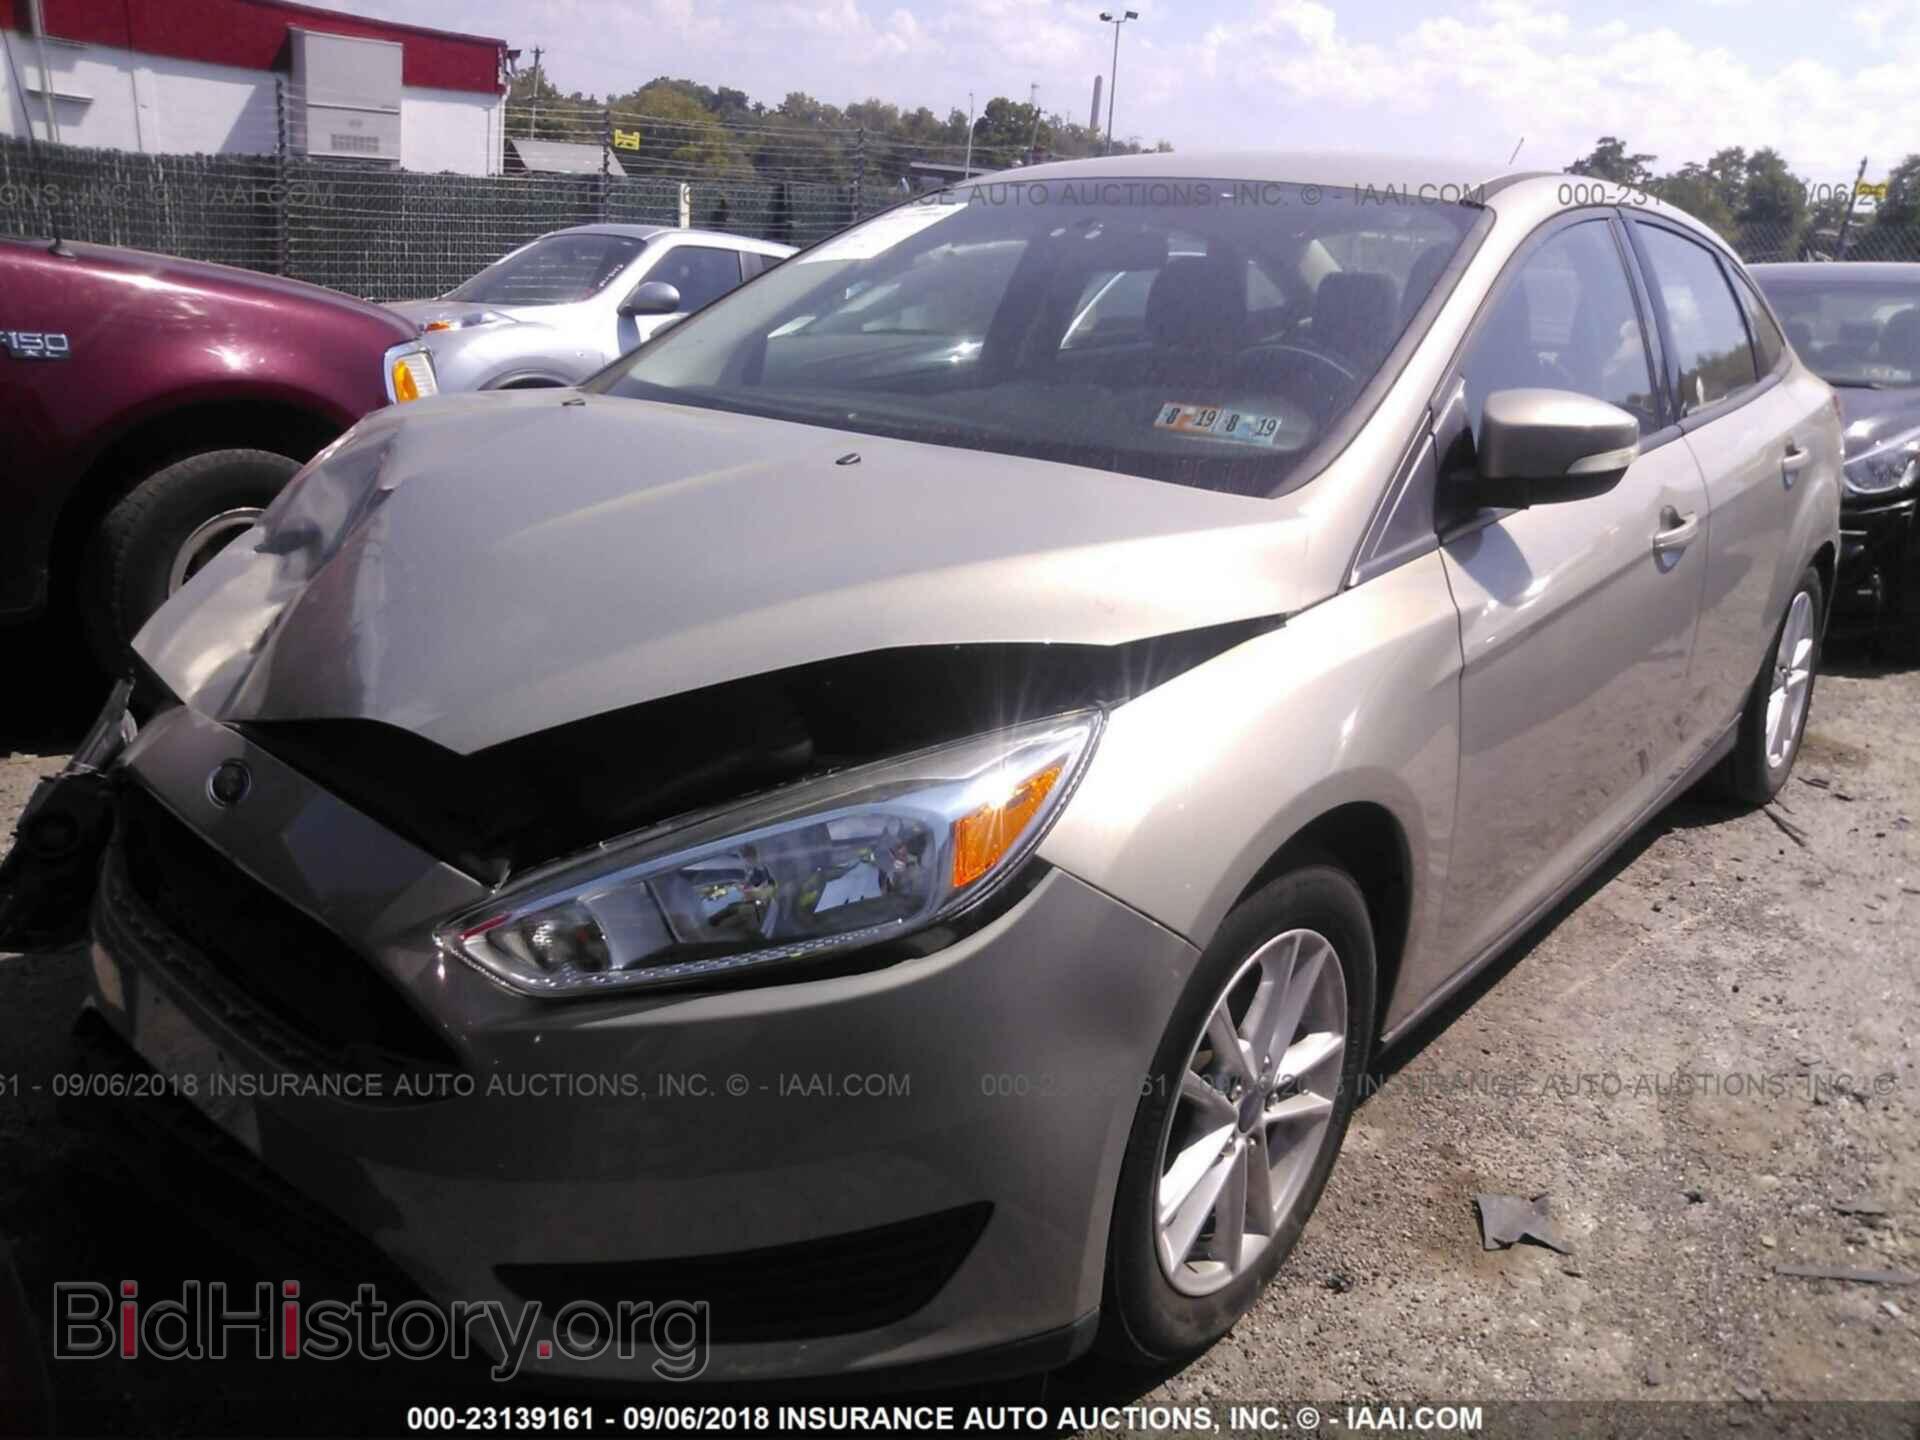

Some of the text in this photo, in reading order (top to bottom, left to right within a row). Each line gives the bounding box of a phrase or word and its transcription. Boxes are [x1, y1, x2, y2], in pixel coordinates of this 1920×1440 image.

[1166, 407, 1277, 437] 8 19 8 19
